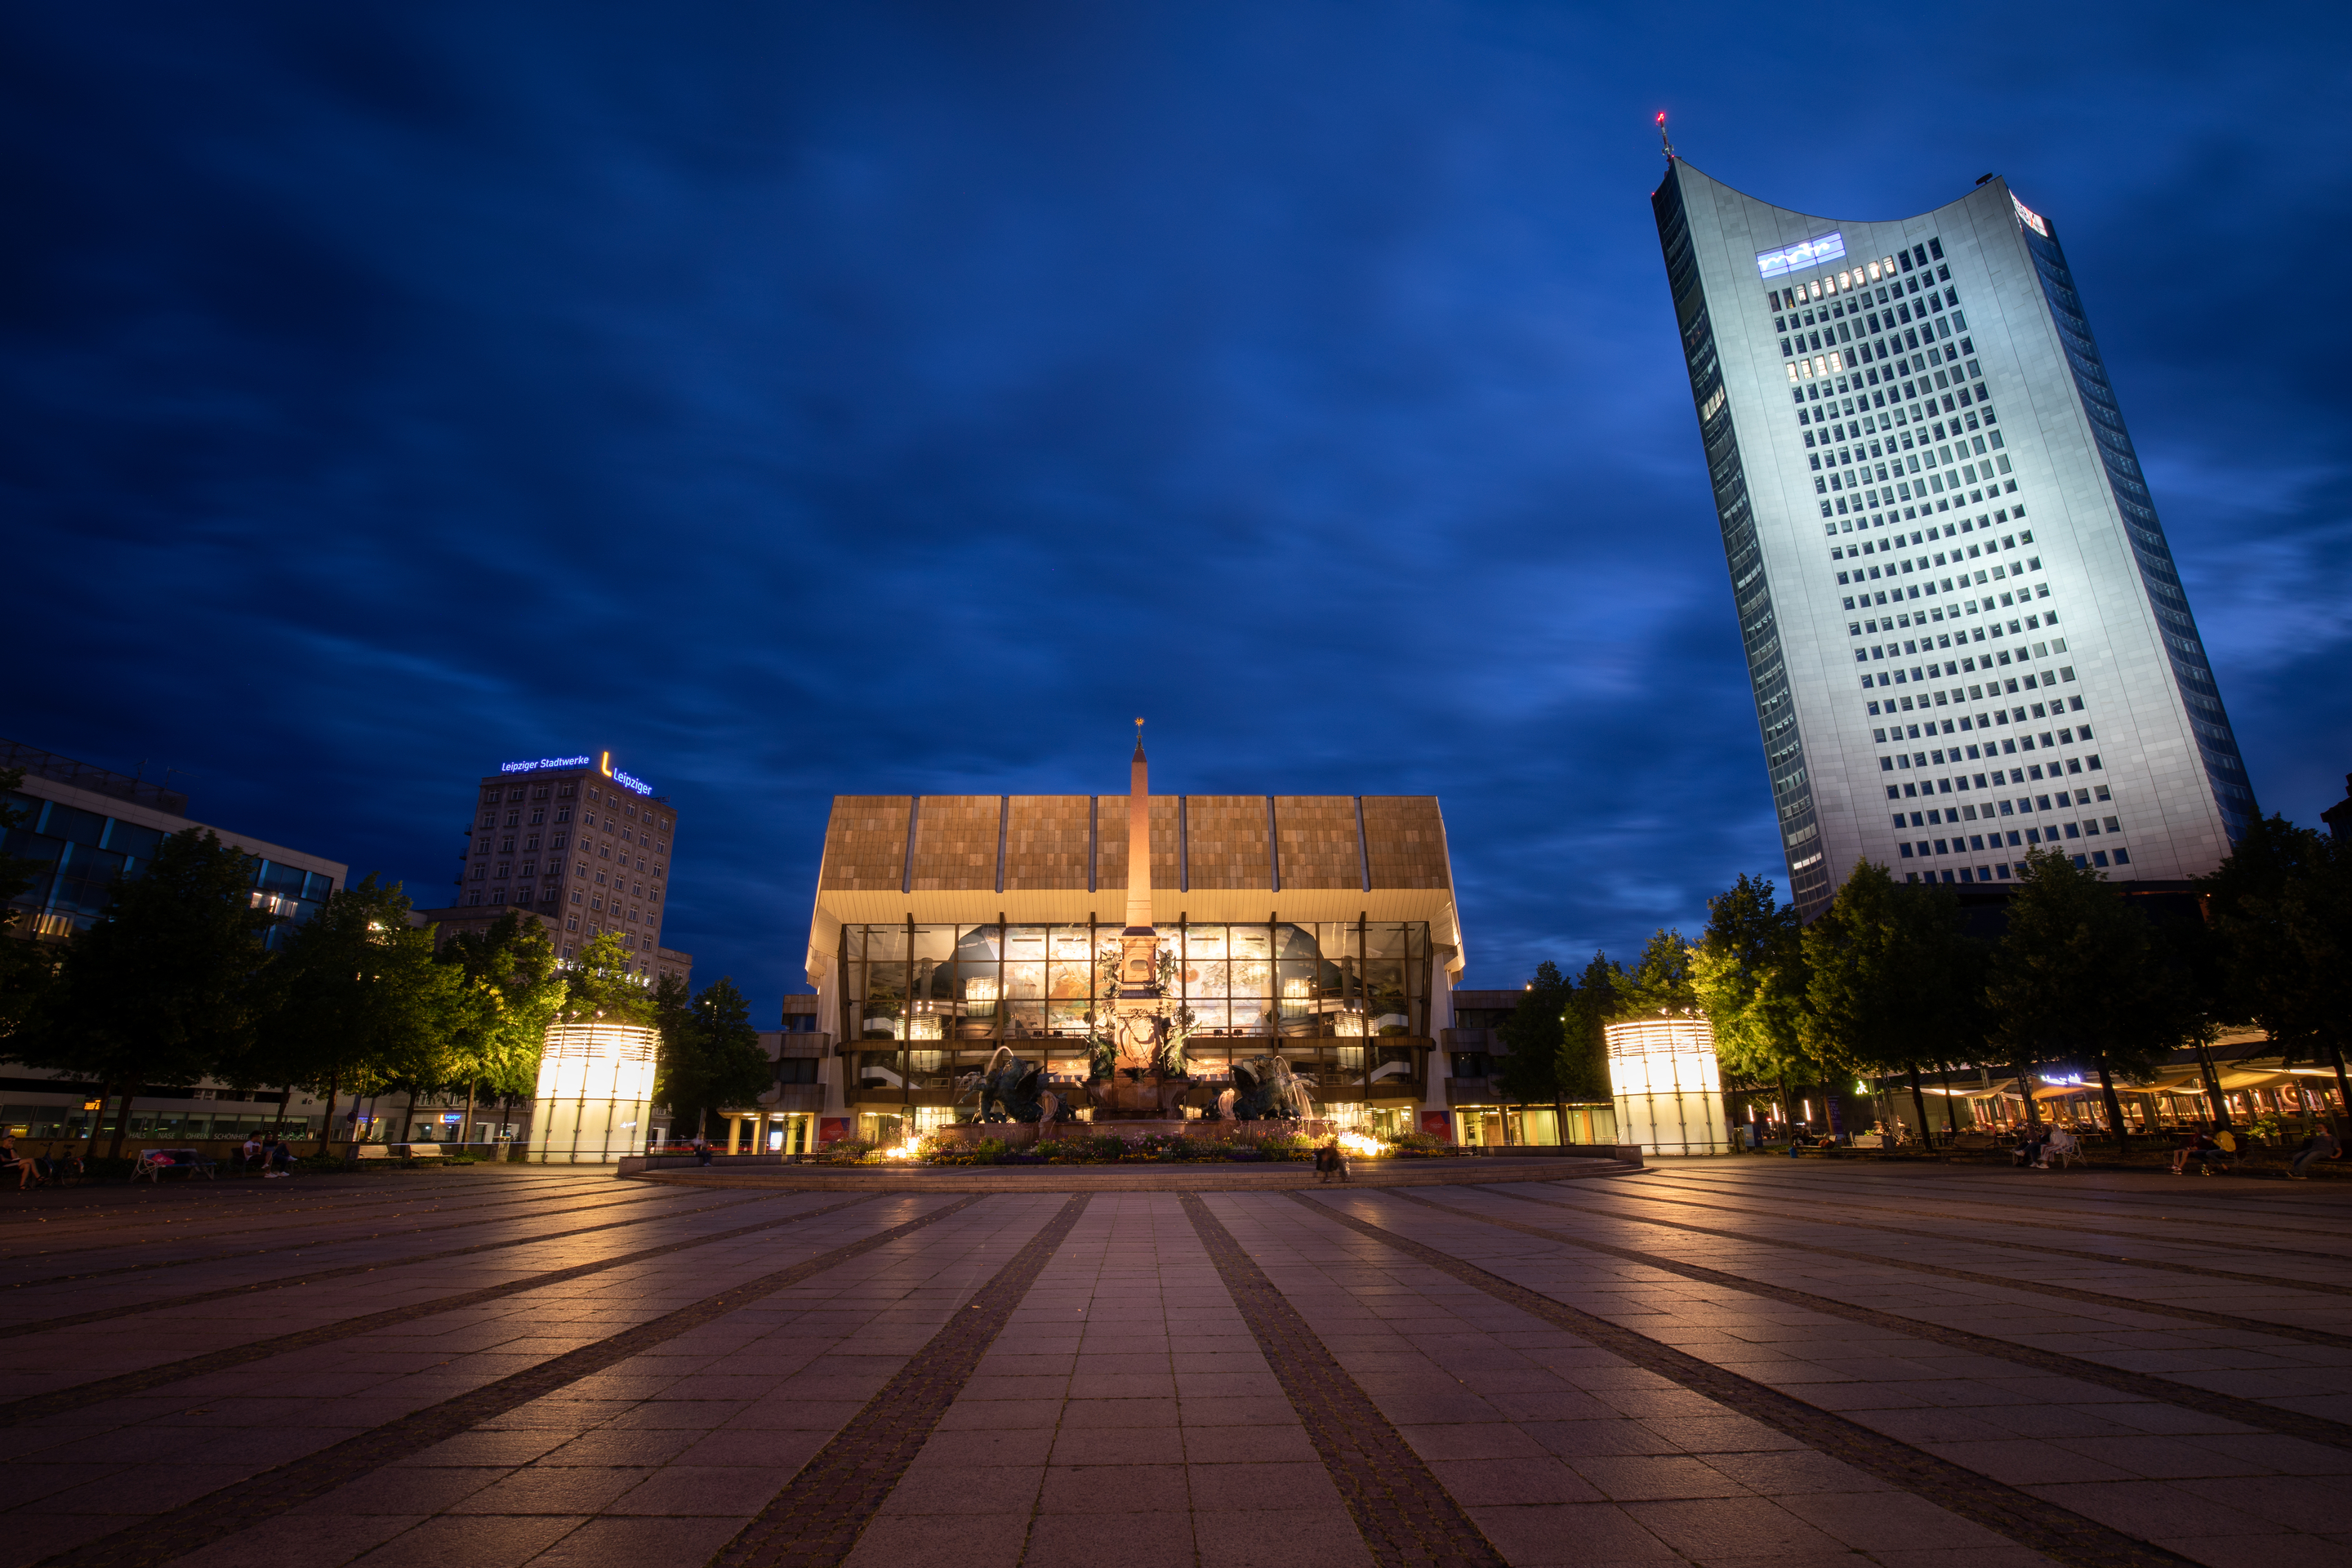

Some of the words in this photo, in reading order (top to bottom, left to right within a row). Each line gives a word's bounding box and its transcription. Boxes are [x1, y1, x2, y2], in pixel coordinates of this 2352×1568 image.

[1758, 243, 1830, 271] mdr
[501, 761, 539, 773] Leipziger
[540, 755, 590, 768] Stadtwerke
[613, 768, 653, 795] Leipziger
[185, 1132, 210, 1140] OHREN
[213, 1132, 250, 1140] SCHÖNHEIT
